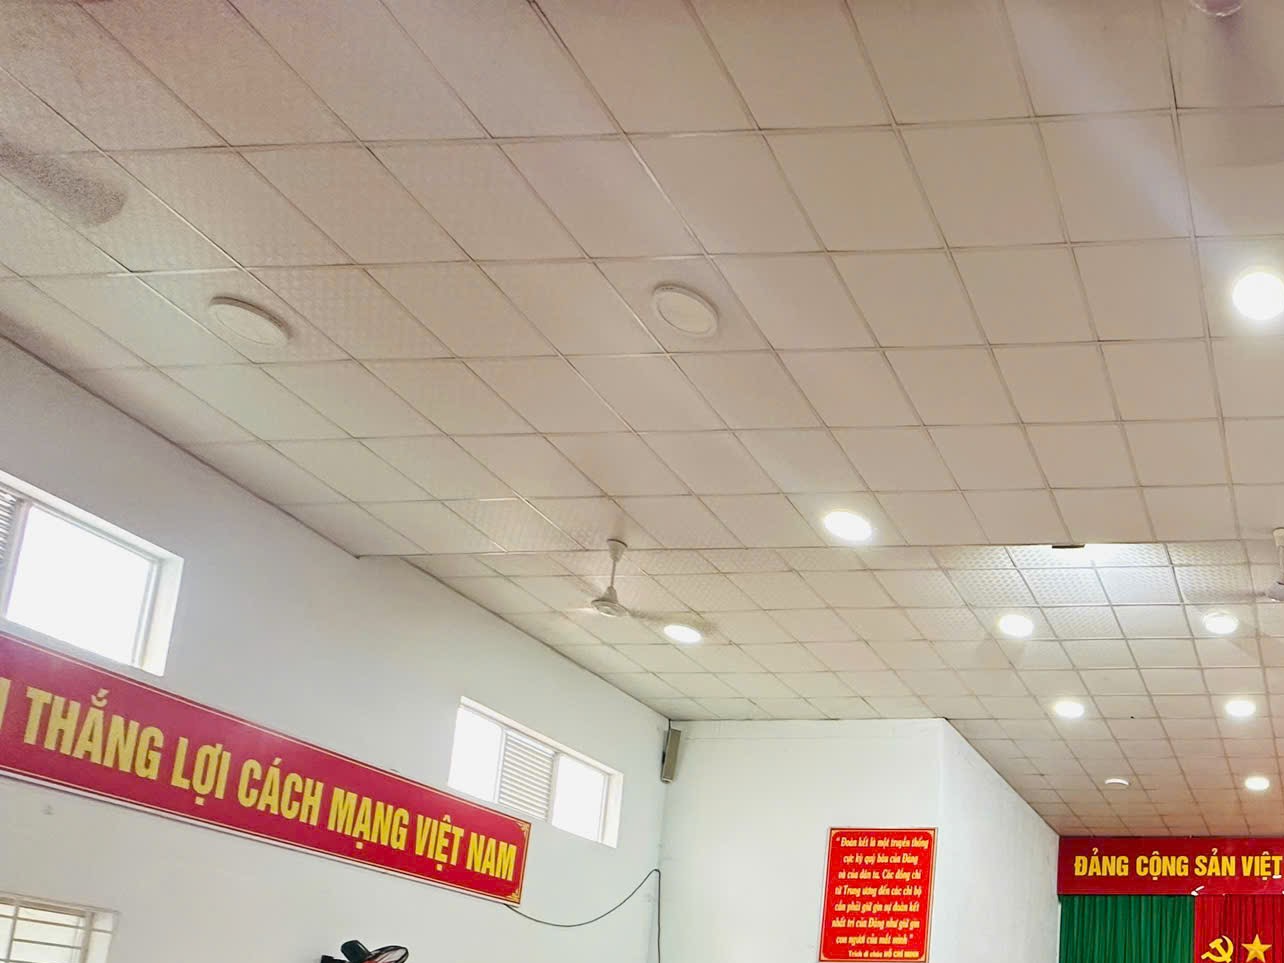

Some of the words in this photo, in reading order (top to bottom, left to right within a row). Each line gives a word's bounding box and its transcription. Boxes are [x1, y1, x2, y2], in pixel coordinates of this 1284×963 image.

[22, 685, 164, 781] THẮNG
[171, 736, 231, 806] LỢI
[237, 757, 324, 825] CÁCH
[328, 787, 409, 849] MẠNG
[415, 815, 464, 872] VIỆT
[466, 831, 518, 882] NAM
[1074, 848, 1129, 876] ĐẢNG
[1136, 851, 1189, 881] CỘNG
[1194, 848, 1236, 876] SẢN
[1241, 851, 1283, 881] VIỆT
